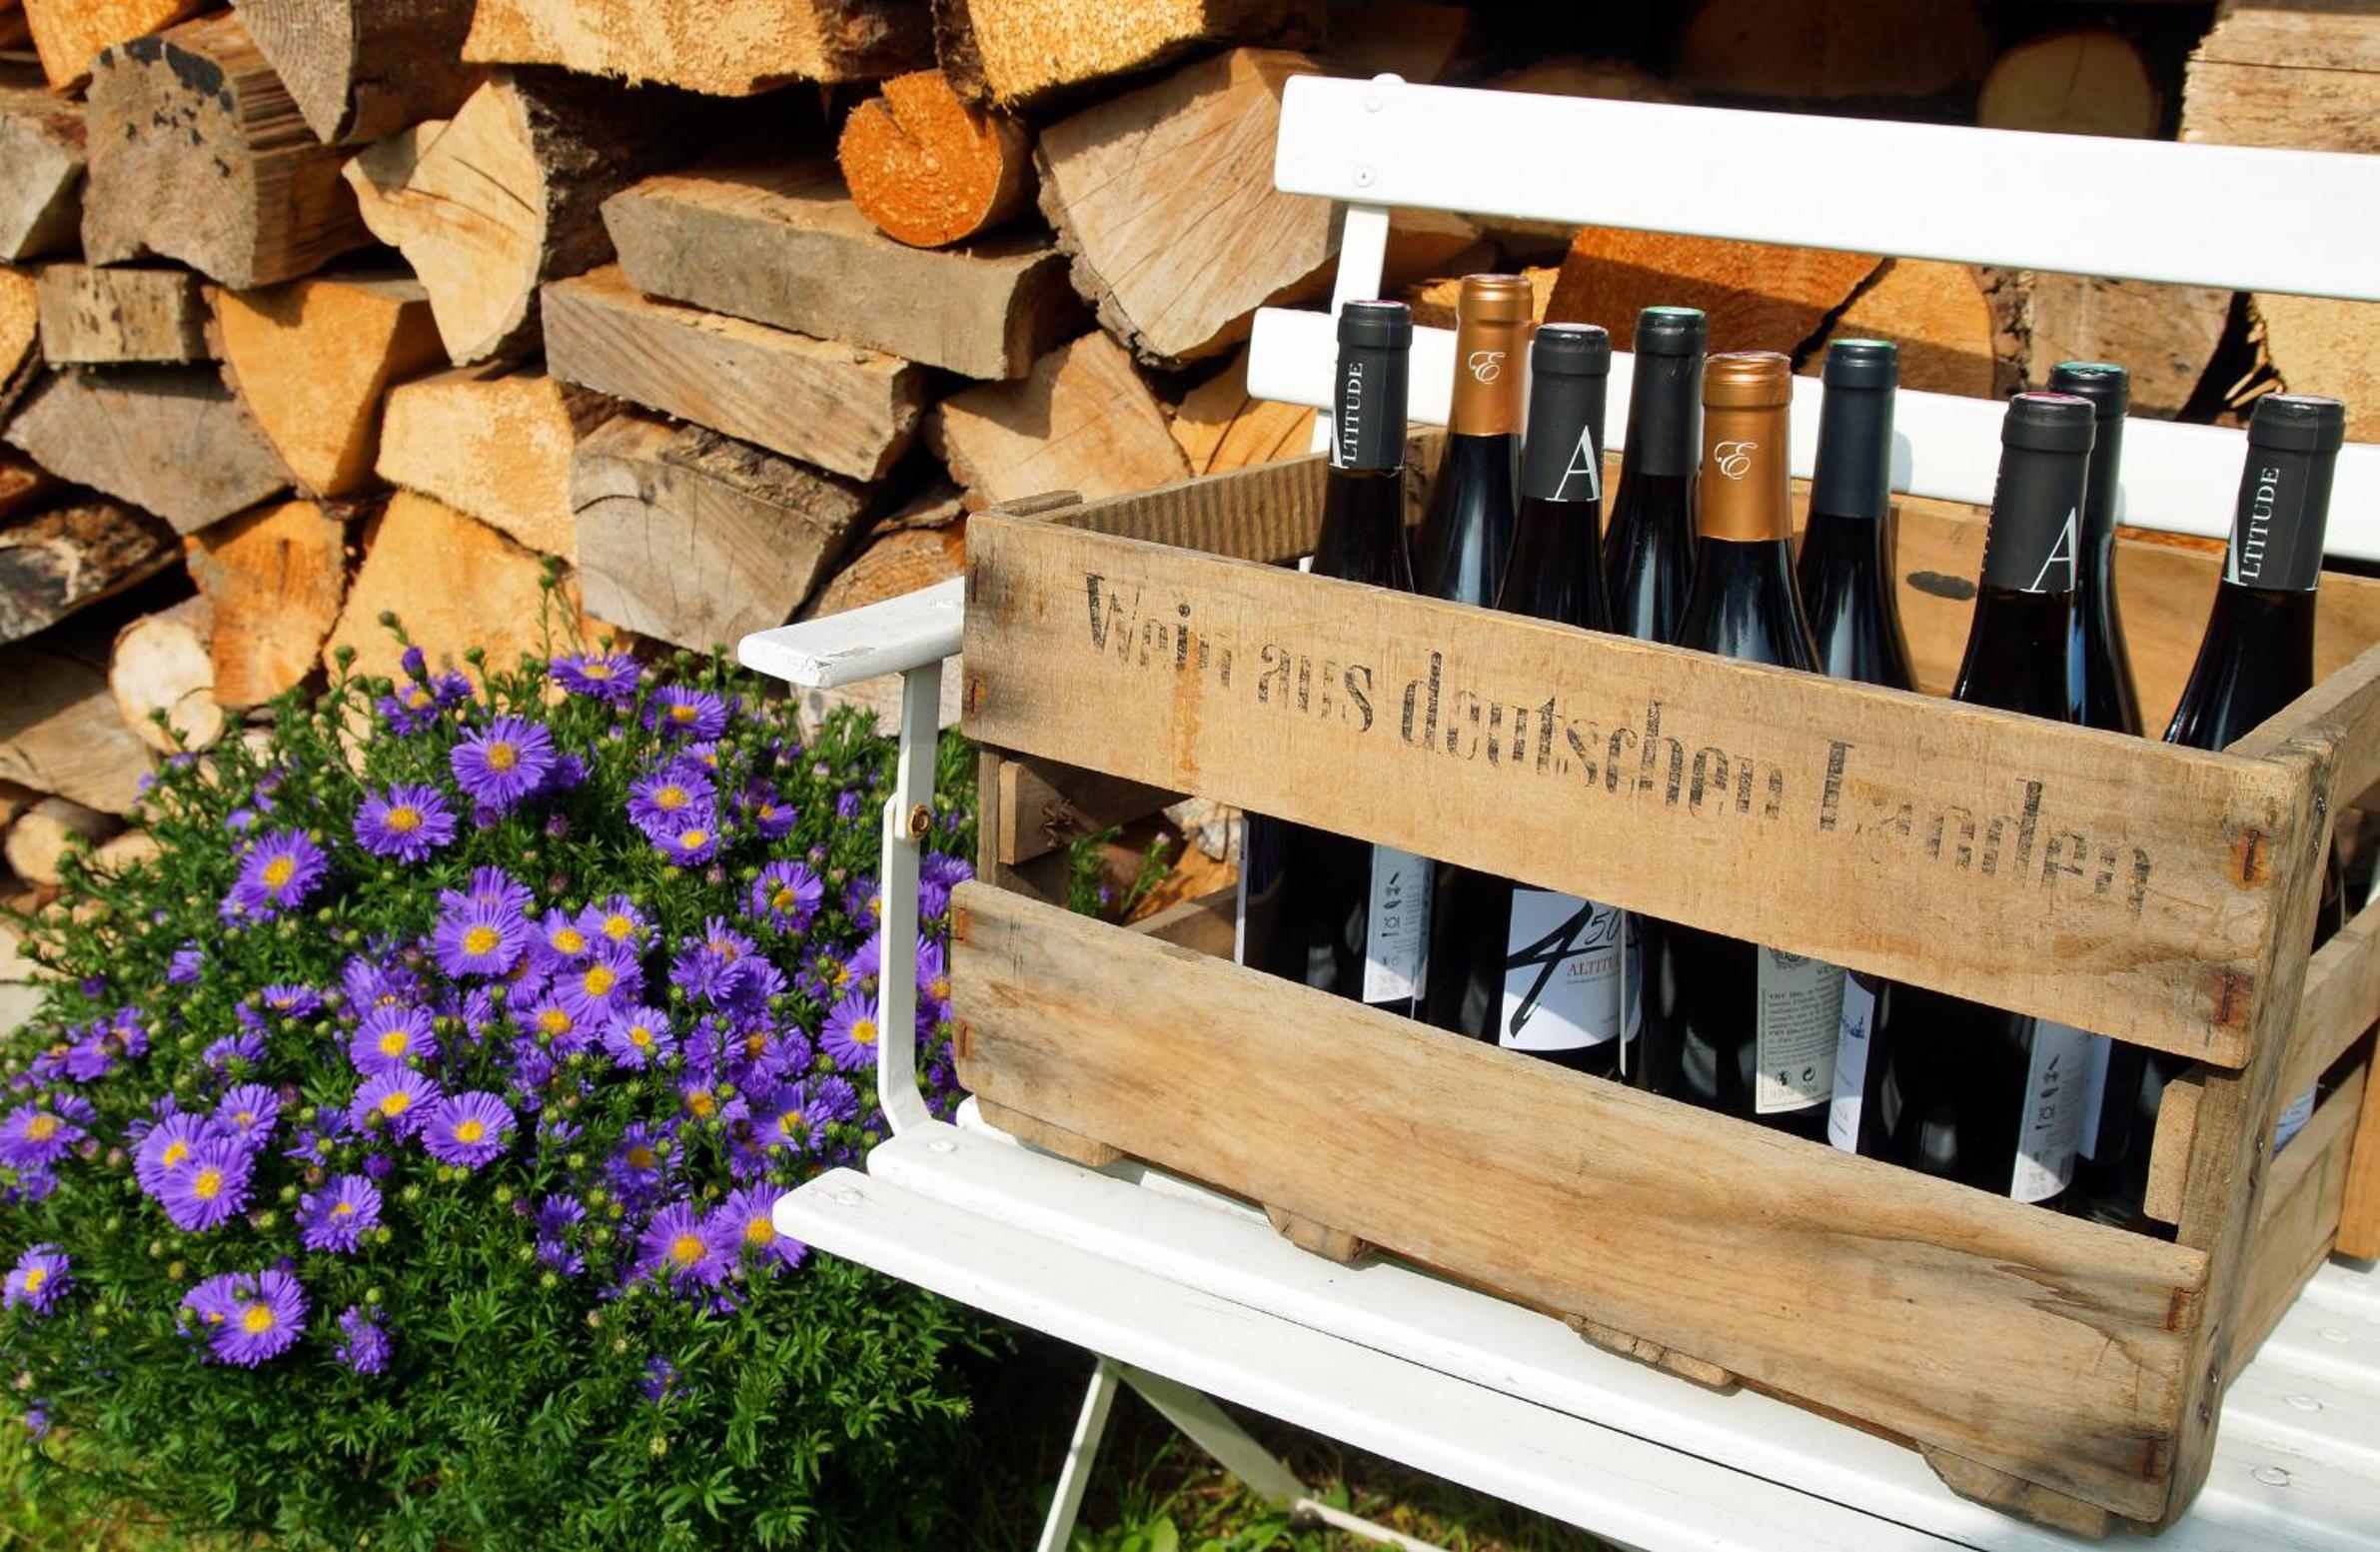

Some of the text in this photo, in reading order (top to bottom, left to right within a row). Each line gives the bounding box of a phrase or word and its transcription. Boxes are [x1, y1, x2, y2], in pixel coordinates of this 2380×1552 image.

[1545, 425, 1602, 503] A
[2018, 507, 2077, 594] A
[1086, 572, 1233, 690] Wein
[1258, 643, 1374, 734] aus
[1401, 650, 1784, 819] deutschen
